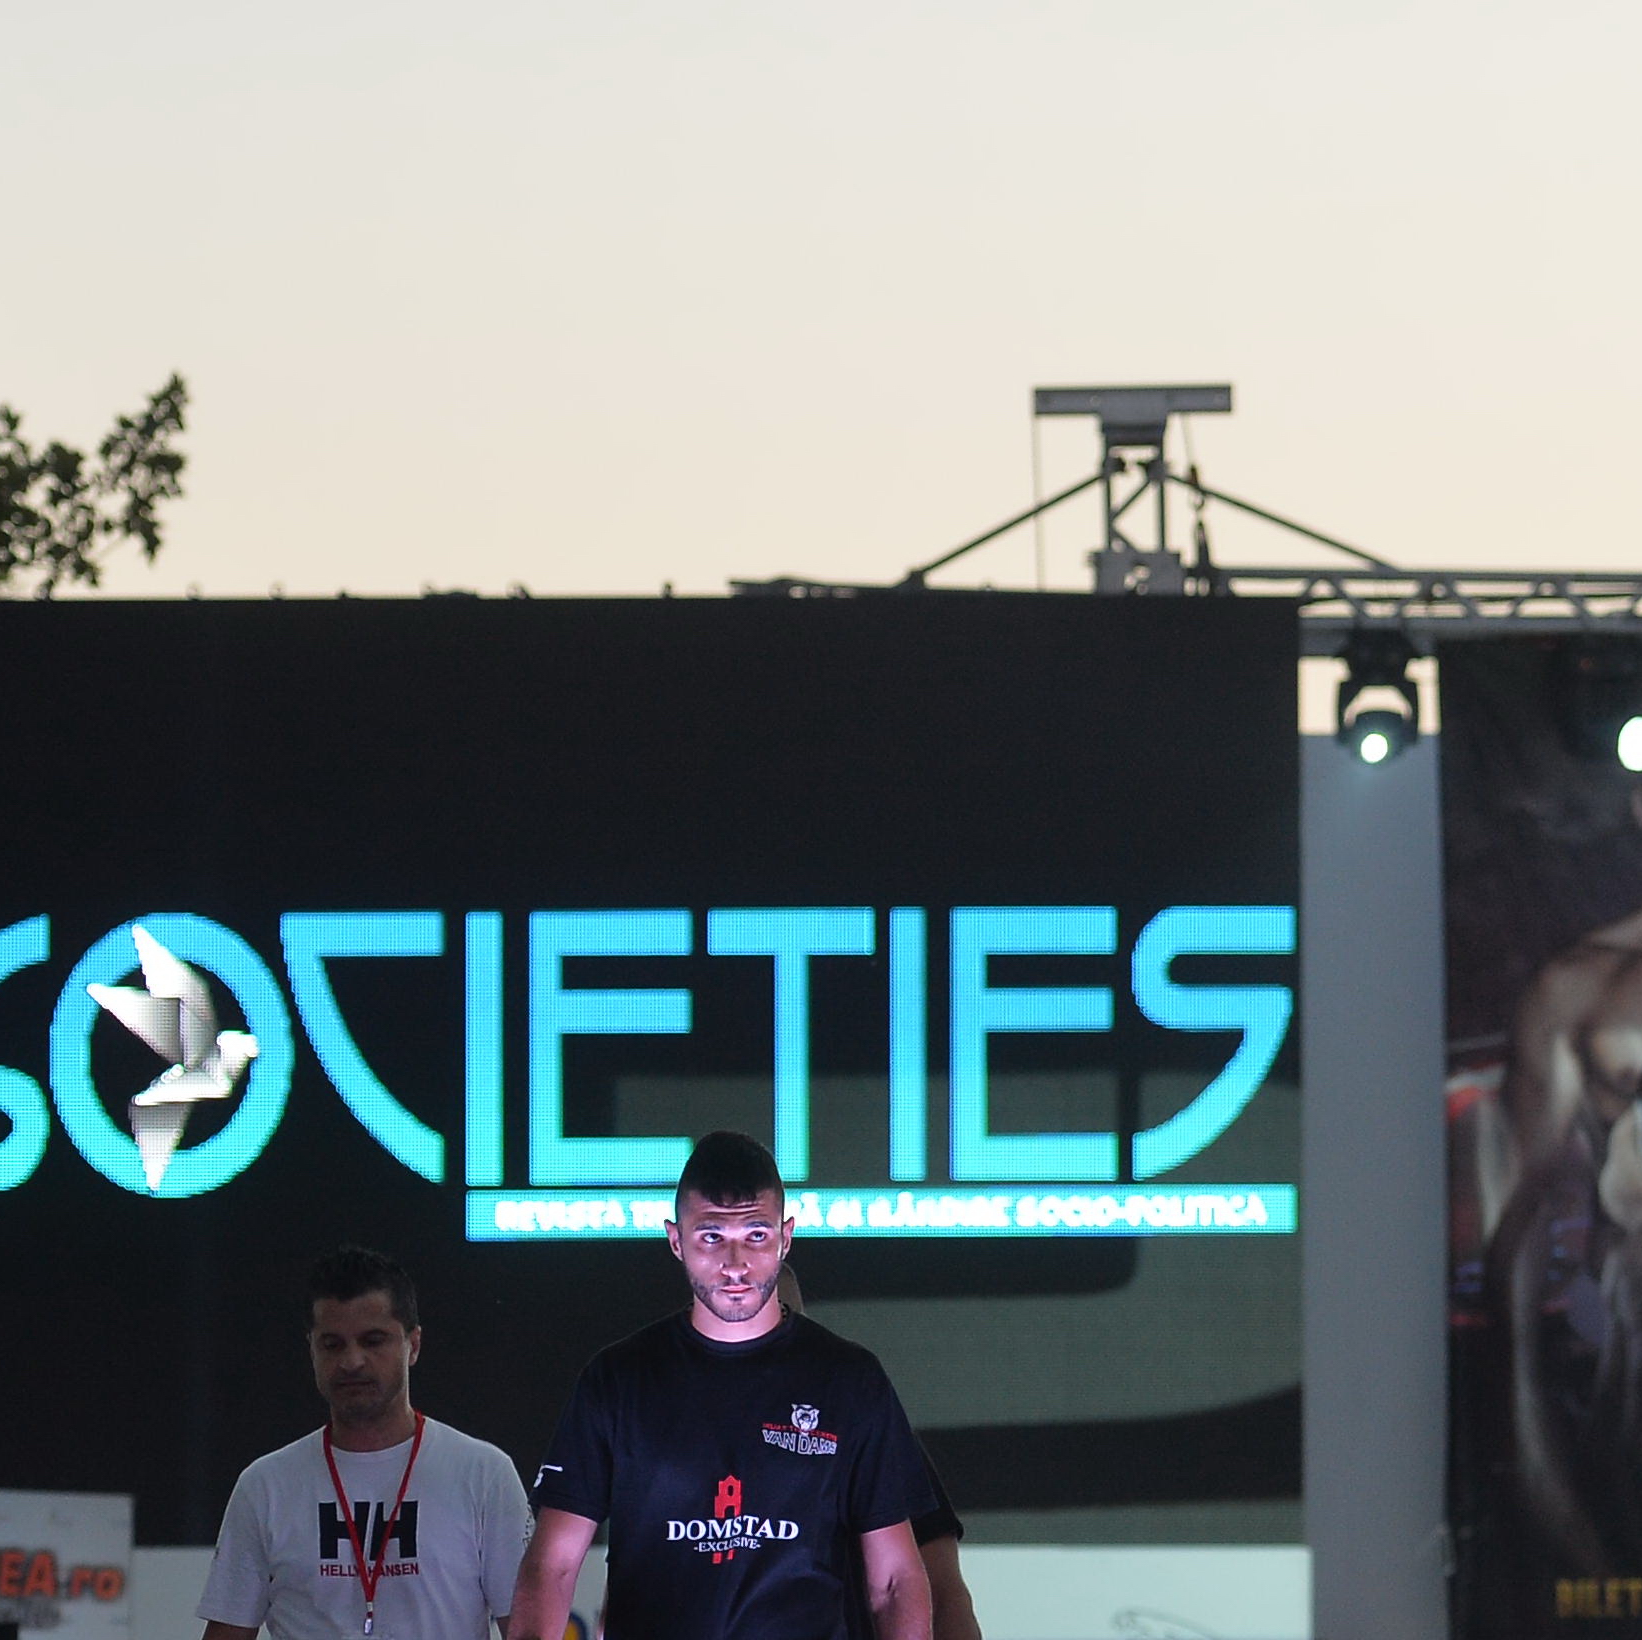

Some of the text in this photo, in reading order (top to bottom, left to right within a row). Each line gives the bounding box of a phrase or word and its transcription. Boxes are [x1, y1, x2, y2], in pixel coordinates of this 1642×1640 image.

[761, 1429, 797, 1453] VAN
[666, 1514, 799, 1541] DOMSTAD
[367, 1562, 419, 1577] HANSEN
